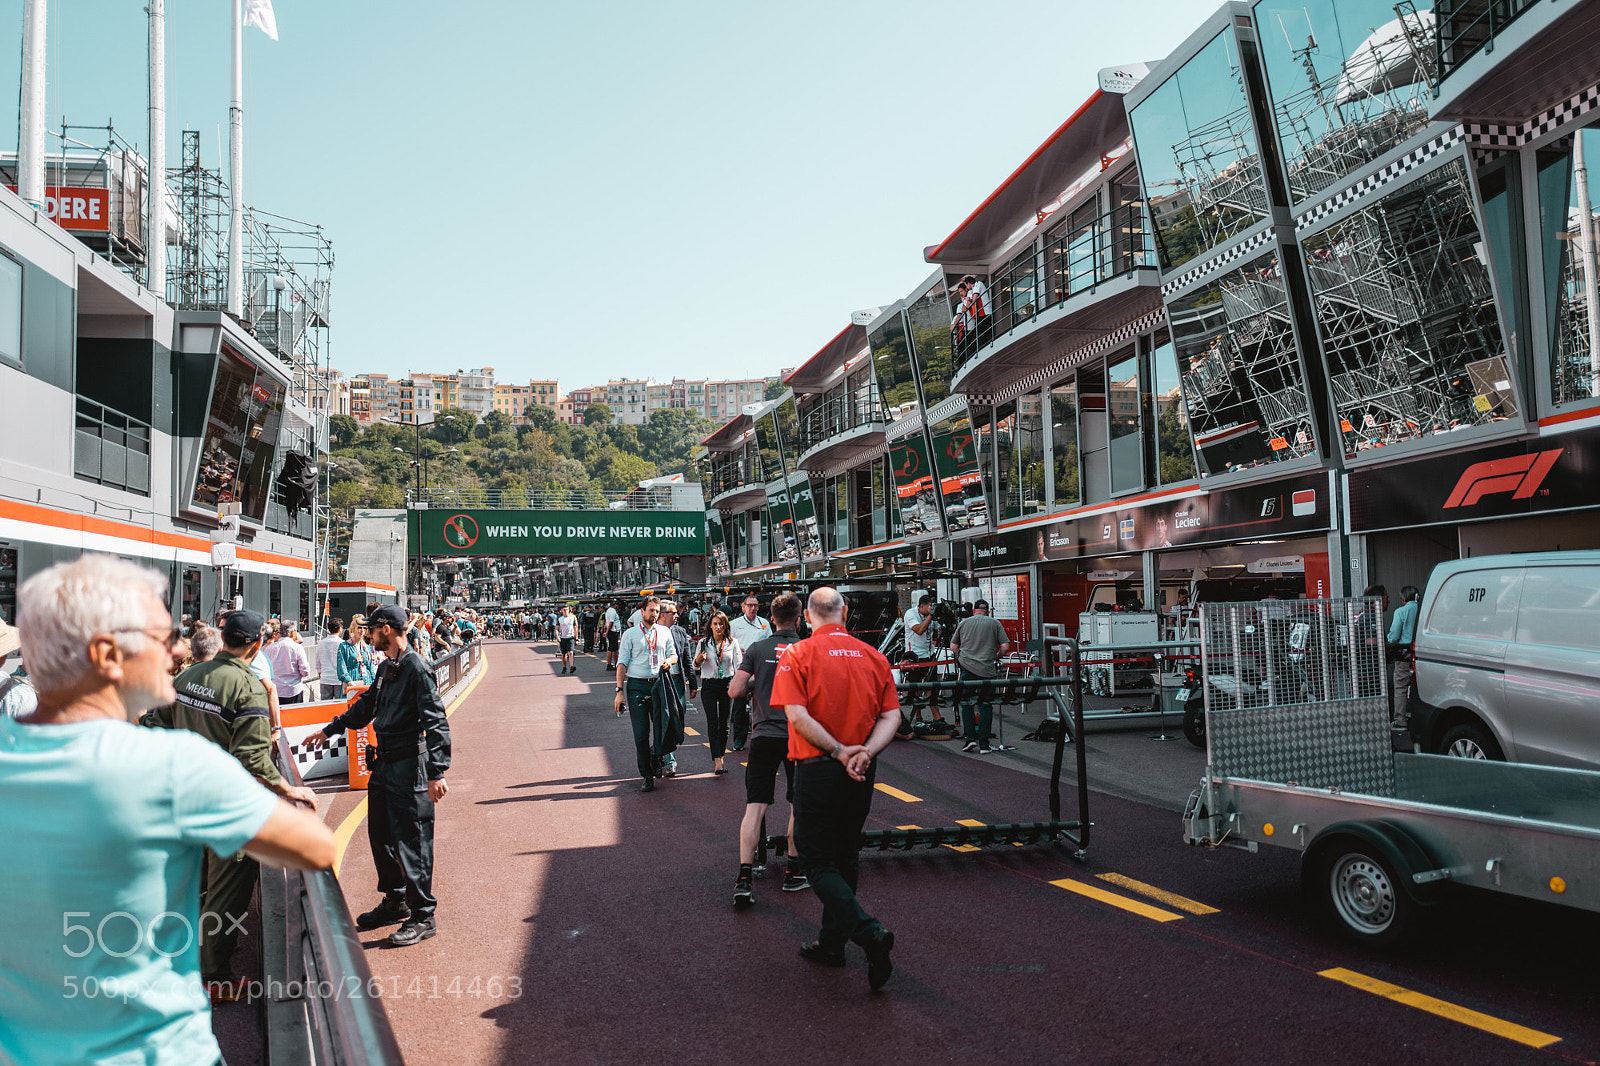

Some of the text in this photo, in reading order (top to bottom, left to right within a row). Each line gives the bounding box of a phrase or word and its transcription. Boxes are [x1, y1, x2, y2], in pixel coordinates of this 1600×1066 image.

[1442, 447, 1564, 509] F1
[1260, 497, 1276, 517] 16
[1175, 517, 1200, 529] Leclerc
[486, 526, 697, 538] WHEN YOU DRIVE NEVER DRINK
[1049, 537, 1070, 547] Ericsson
[1468, 587, 1486, 603] BTP
[828, 649, 863, 658] OFFICIEL
